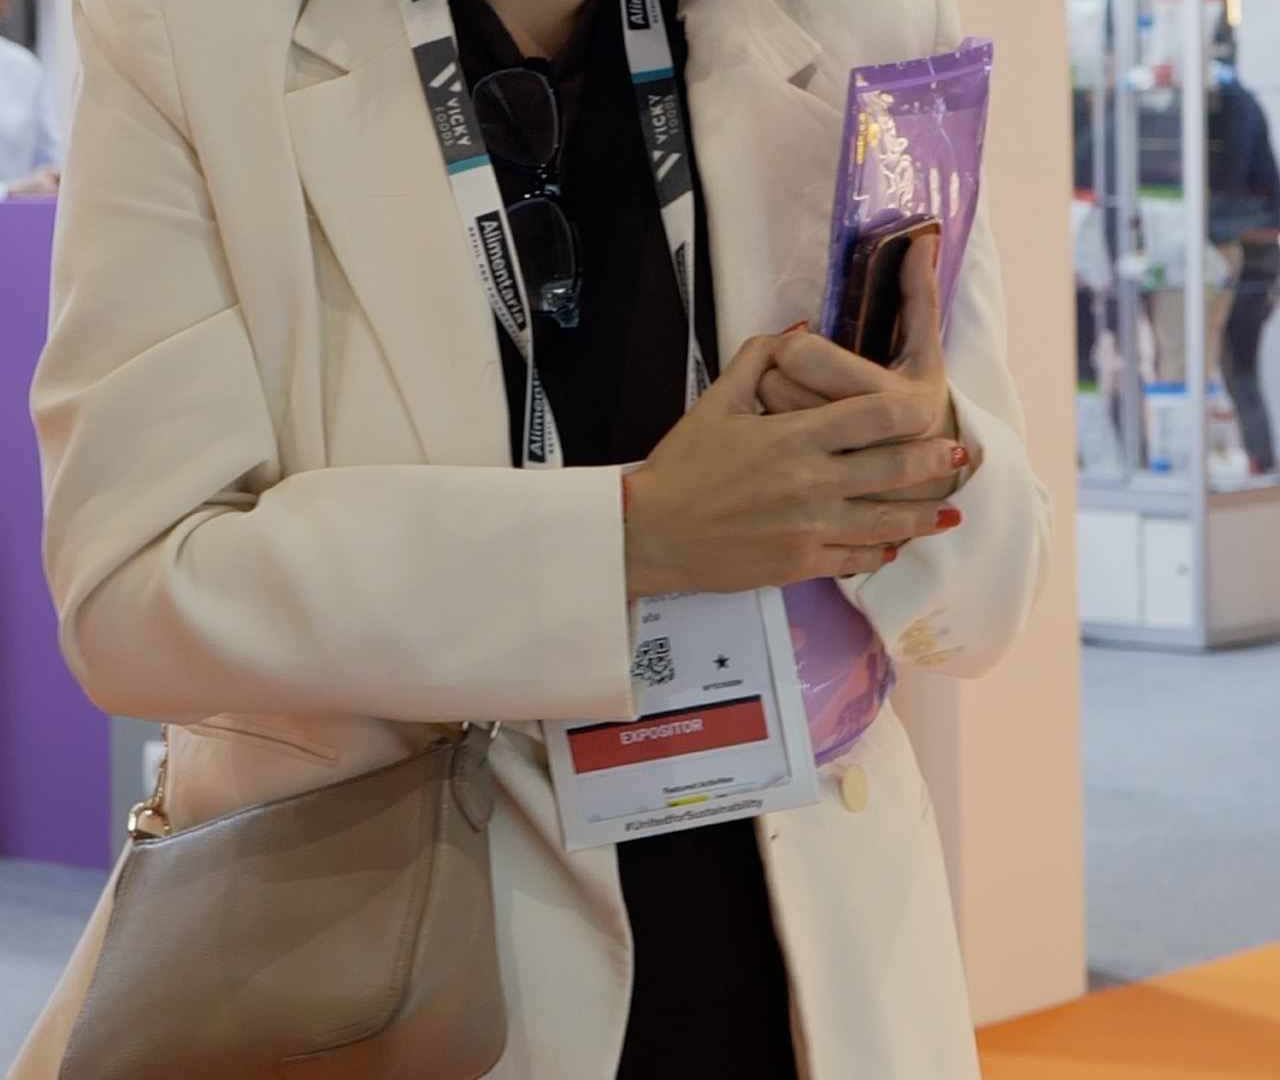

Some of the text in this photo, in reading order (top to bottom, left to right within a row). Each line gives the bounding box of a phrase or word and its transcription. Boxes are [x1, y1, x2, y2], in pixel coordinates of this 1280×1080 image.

[434, 106, 456, 148] FOODS
[446, 97, 472, 147] VICKY
[648, 94, 669, 145] VICKY
[480, 220, 525, 324] Alimentaria
[621, 718, 704, 745] EXPOSITOR
